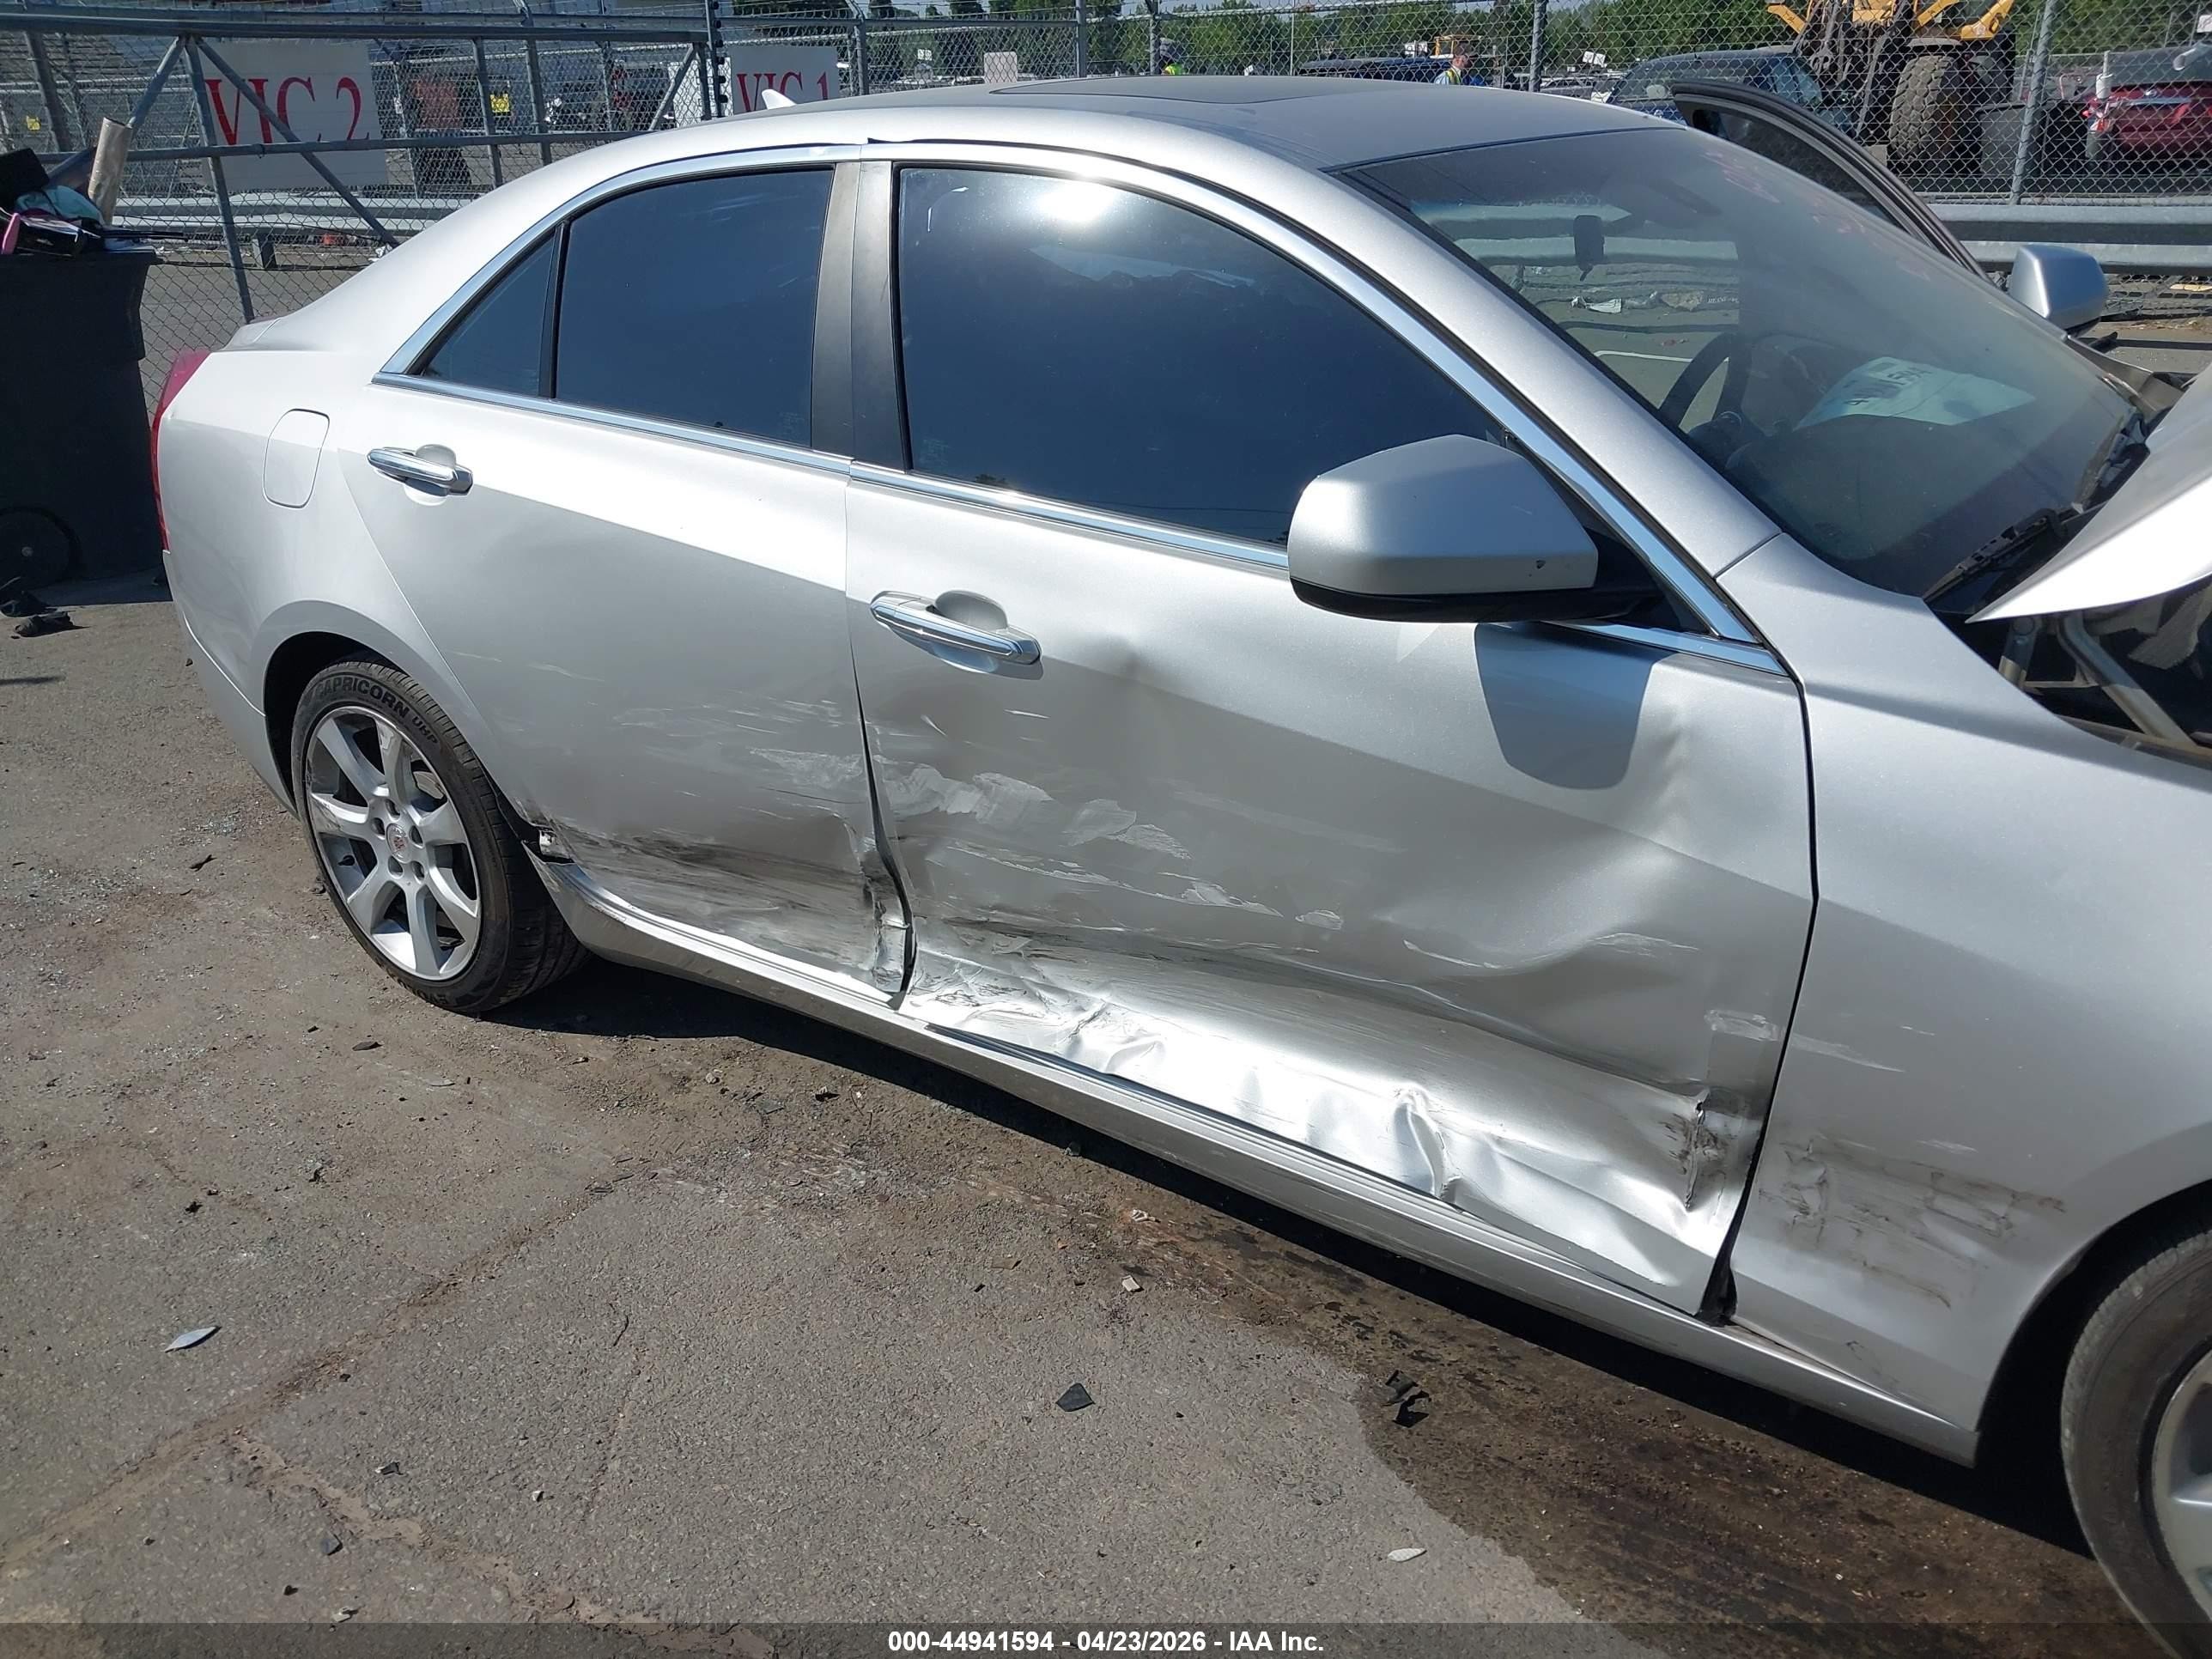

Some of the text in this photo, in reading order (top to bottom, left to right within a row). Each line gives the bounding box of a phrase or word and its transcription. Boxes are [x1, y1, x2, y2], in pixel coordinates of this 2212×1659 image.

[204, 76, 369, 145] VIC 2
[817, 71, 829, 100] 1
[315, 676, 440, 744] CAPRICORN UHP
